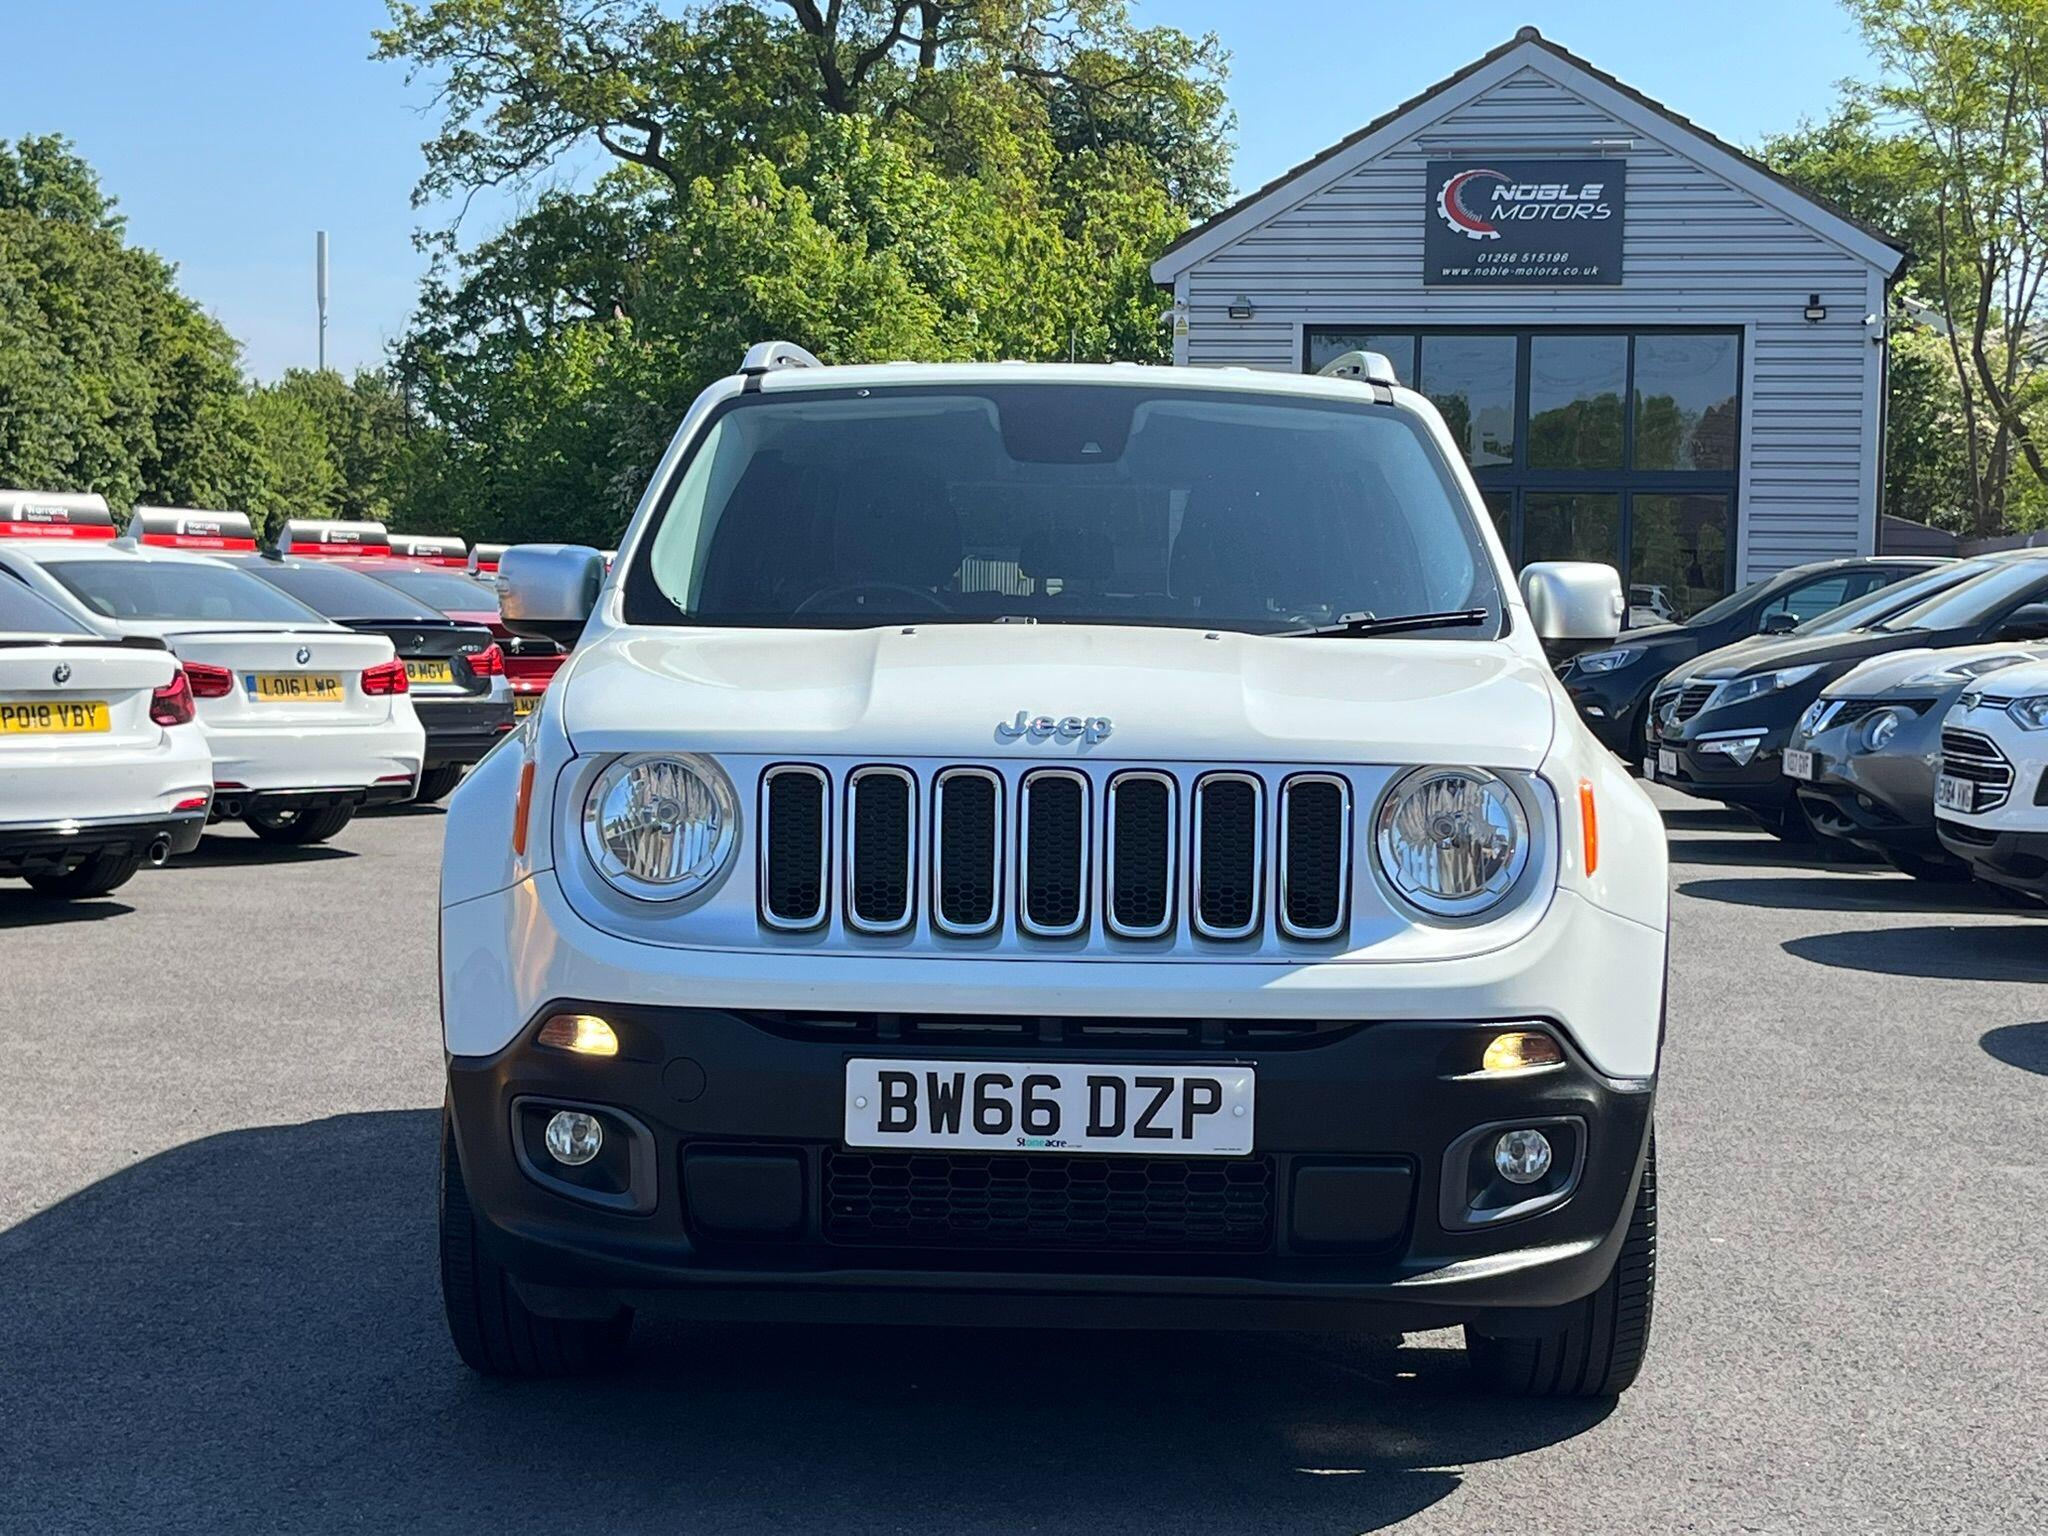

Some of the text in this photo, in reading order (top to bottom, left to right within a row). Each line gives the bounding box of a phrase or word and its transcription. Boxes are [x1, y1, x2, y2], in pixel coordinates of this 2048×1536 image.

[1491, 184, 1604, 200] NOBLE
[1490, 203, 1611, 220] MOTORS
[1442, 264, 1599, 276] www.noble-motors.co.uk
[1, 704, 97, 729] PO18 VBY
[999, 710, 1114, 745] Jeep
[877, 1070, 1223, 1140] BW66 DZP
[1016, 1137, 1067, 1148] Stoneacre
